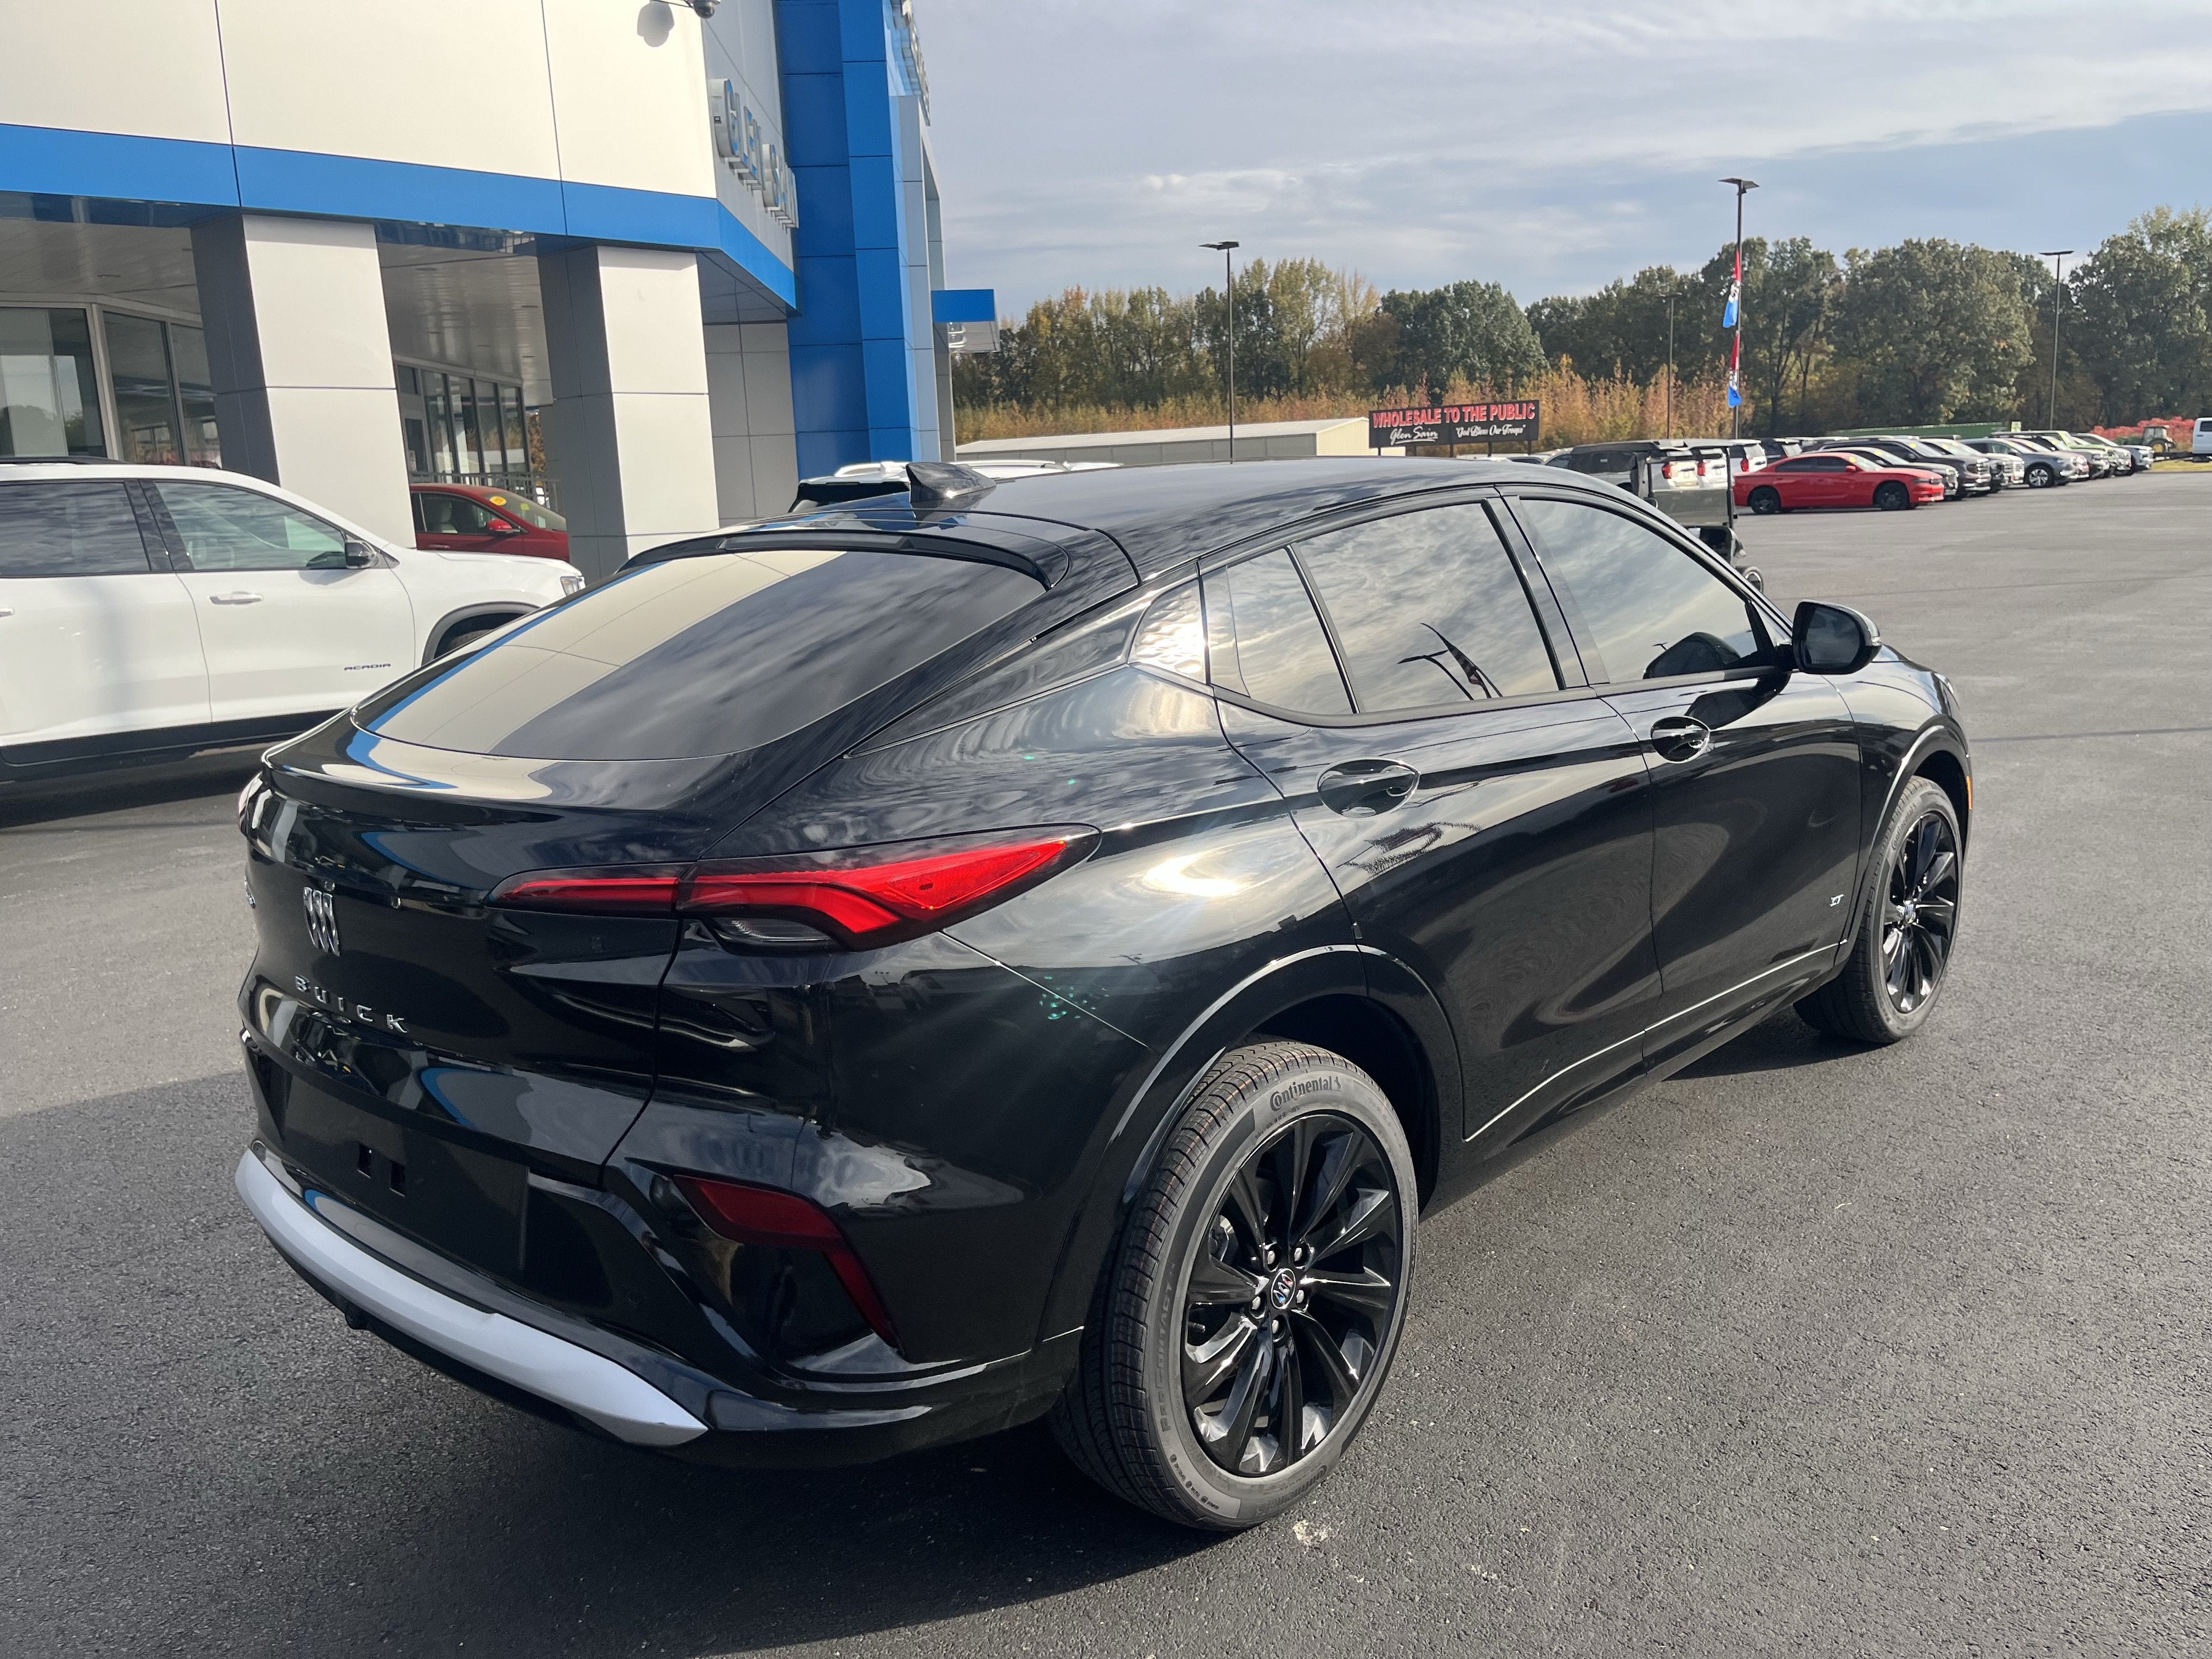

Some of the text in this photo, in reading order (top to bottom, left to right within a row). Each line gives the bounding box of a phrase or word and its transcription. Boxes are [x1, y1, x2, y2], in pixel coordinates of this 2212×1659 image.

[1373, 402, 1536, 428] WHOLESALE TO THE PUBLIC
[1390, 428, 1412, 445] Glen
[295, 974, 408, 1033] BUICK
[1269, 1076, 1332, 1111] Continental
